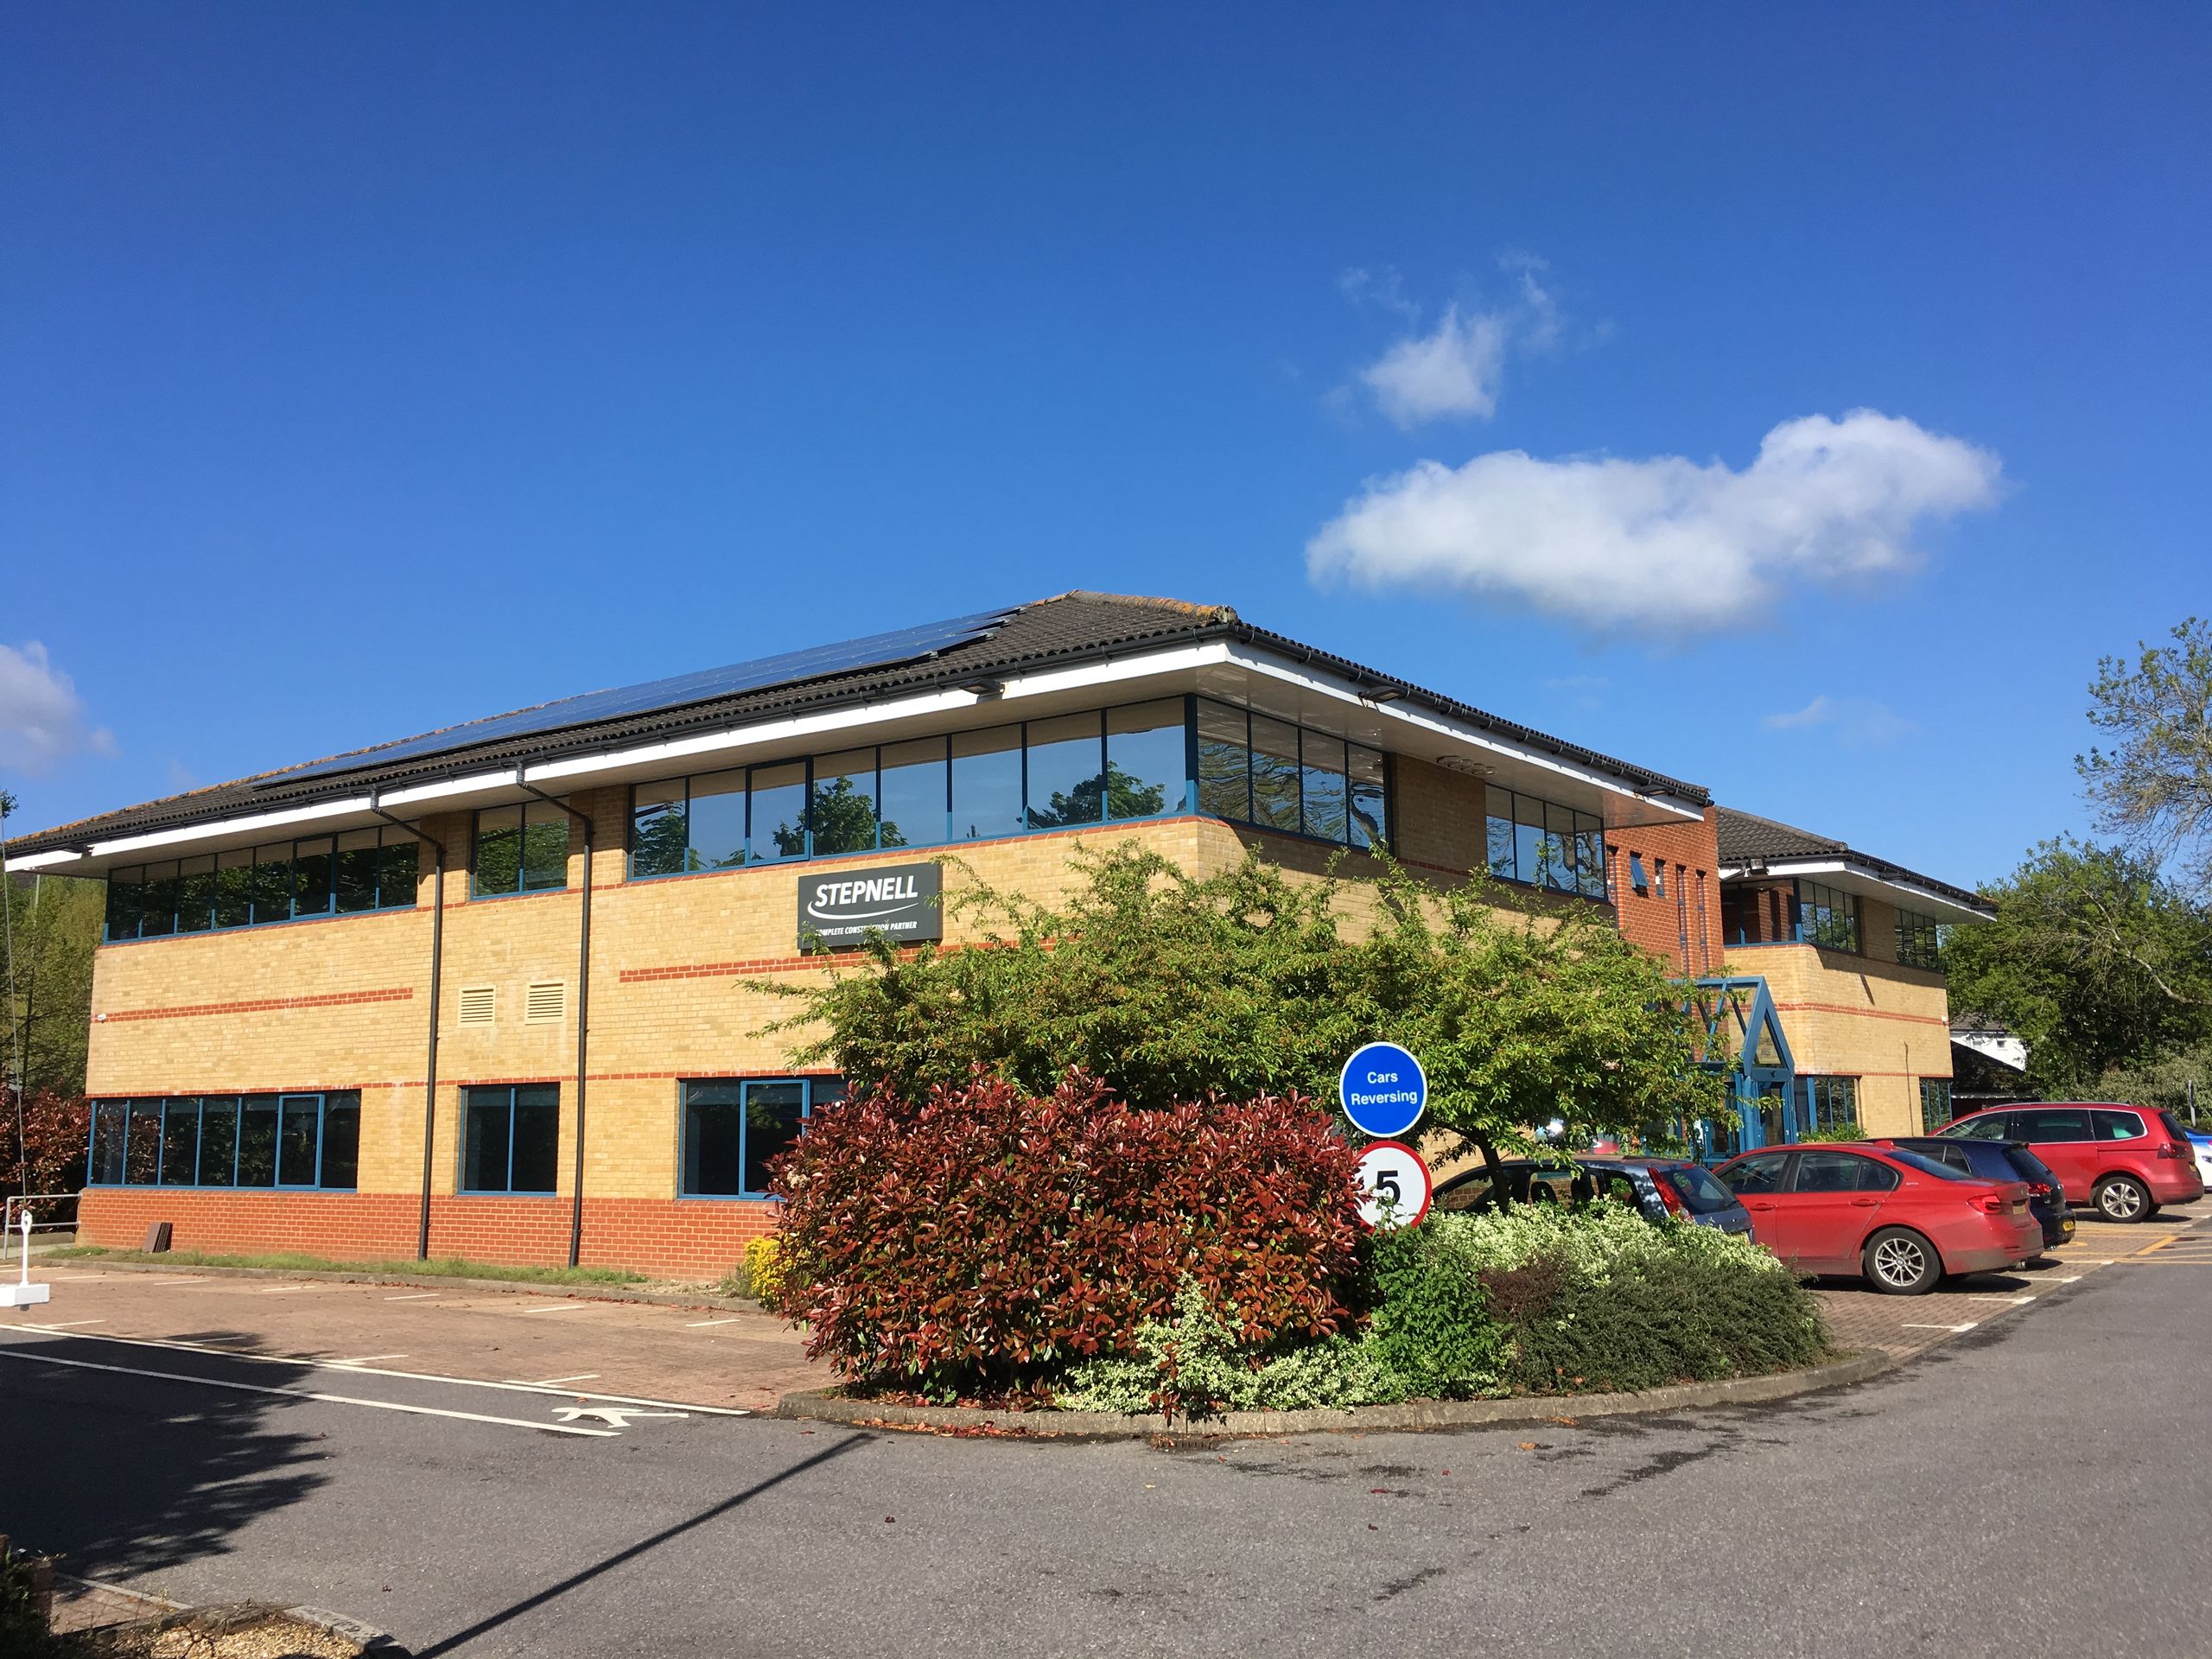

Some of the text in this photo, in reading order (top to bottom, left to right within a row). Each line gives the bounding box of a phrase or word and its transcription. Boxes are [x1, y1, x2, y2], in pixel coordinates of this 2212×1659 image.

[815, 875, 918, 907] STEPNELL
[890, 921, 918, 931] PARTNER
[1367, 1071, 1398, 1084] Cars
[1351, 1090, 1418, 1105] Reversing
[1376, 1170, 1401, 1207] 5
